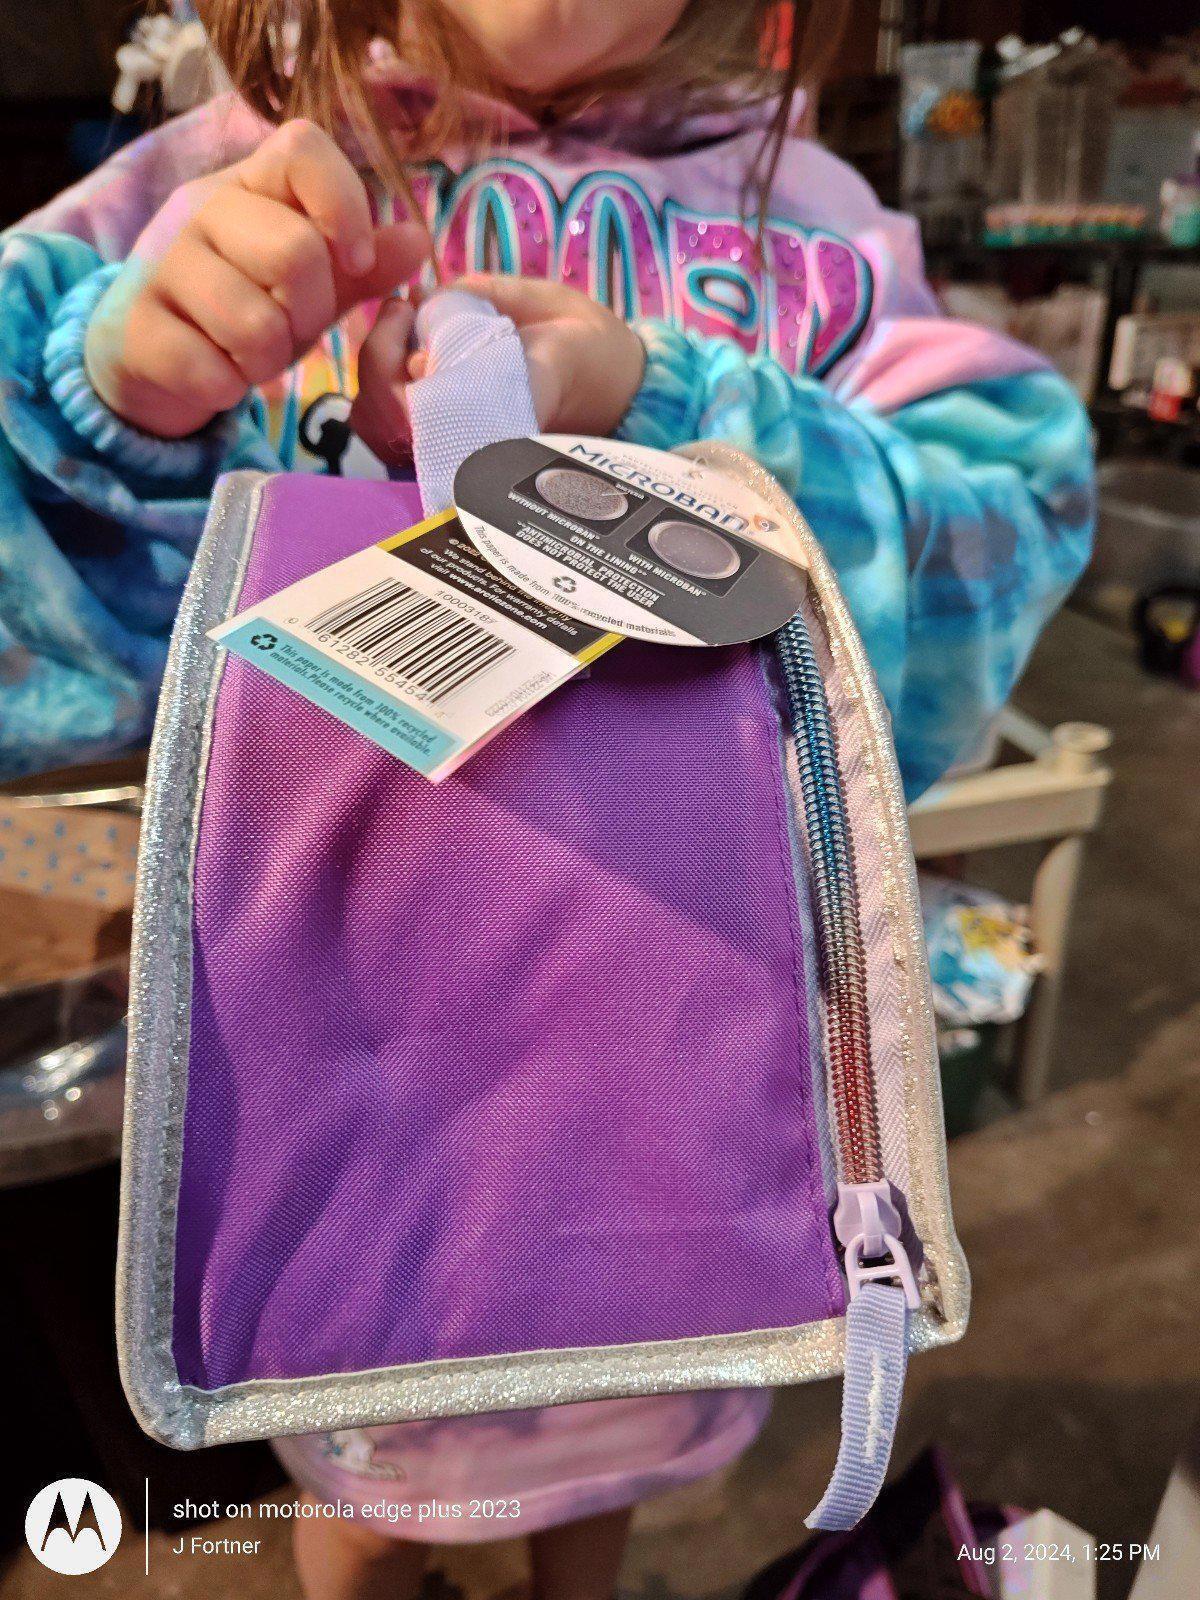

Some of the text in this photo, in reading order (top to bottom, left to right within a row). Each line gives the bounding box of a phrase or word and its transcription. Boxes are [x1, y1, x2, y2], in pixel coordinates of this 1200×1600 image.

[508, 491, 549, 516] WITHOUT
[570, 535, 585, 547] ON
[586, 541, 606, 557] THE
[629, 554, 653, 571] WITH
[430, 563, 451, 576] visit
[444, 549, 460, 560] We
[459, 555, 485, 574] stand
[484, 567, 517, 591] behind
[474, 525, 487, 545] This
[484, 540, 501, 560] paper
[499, 557, 509, 566] is
[507, 563, 530, 583] made
[529, 579, 550, 596] from
[579, 607, 624, 628] recycled
[515, 531, 656, 608] DOES NOT PROTECT THE USER
[599, 564, 660, 601] PROTECTION
[420, 547, 431, 555] of
[430, 553, 448, 565] our
[489, 584, 507, 597] For
[505, 593, 547, 619] warranty
[546, 614, 579, 636] details
[318, 633, 370, 666] 61282
[374, 666, 428, 702] 55454
[279, 644, 438, 744] This paper is made from 100% recycled
[333, 690, 364, 712] recycle
[364, 710, 390, 729] where
